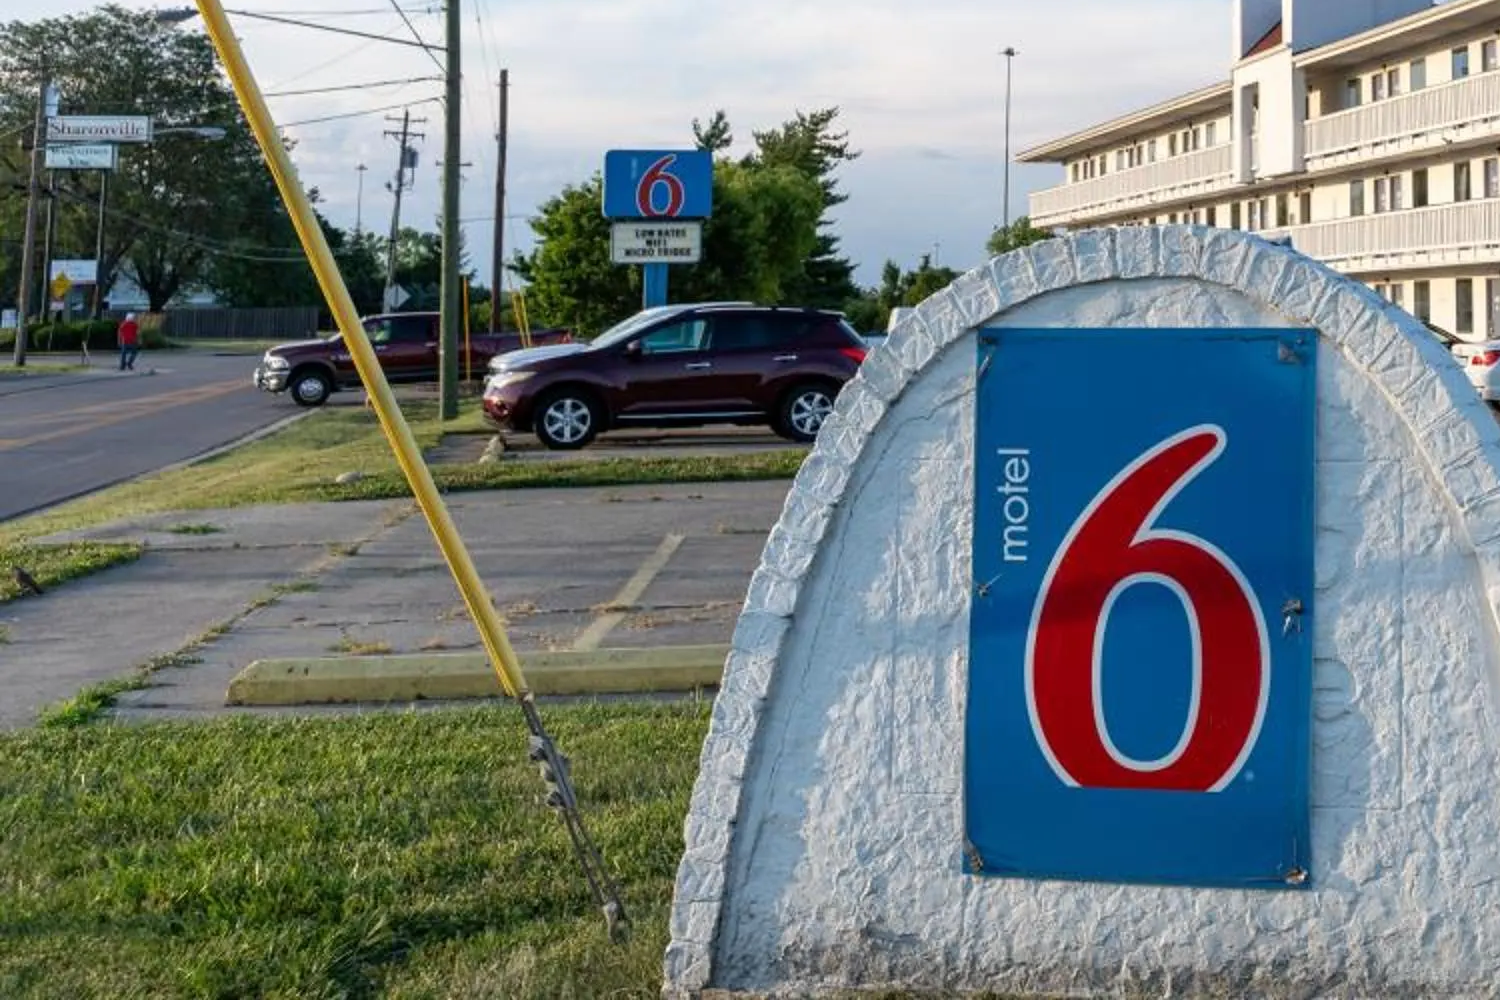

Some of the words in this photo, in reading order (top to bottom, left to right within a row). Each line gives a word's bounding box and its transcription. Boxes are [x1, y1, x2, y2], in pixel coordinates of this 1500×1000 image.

[636, 153, 684, 217] 6
[997, 448, 1030, 561] motel
[1024, 423, 1270, 792] 6
